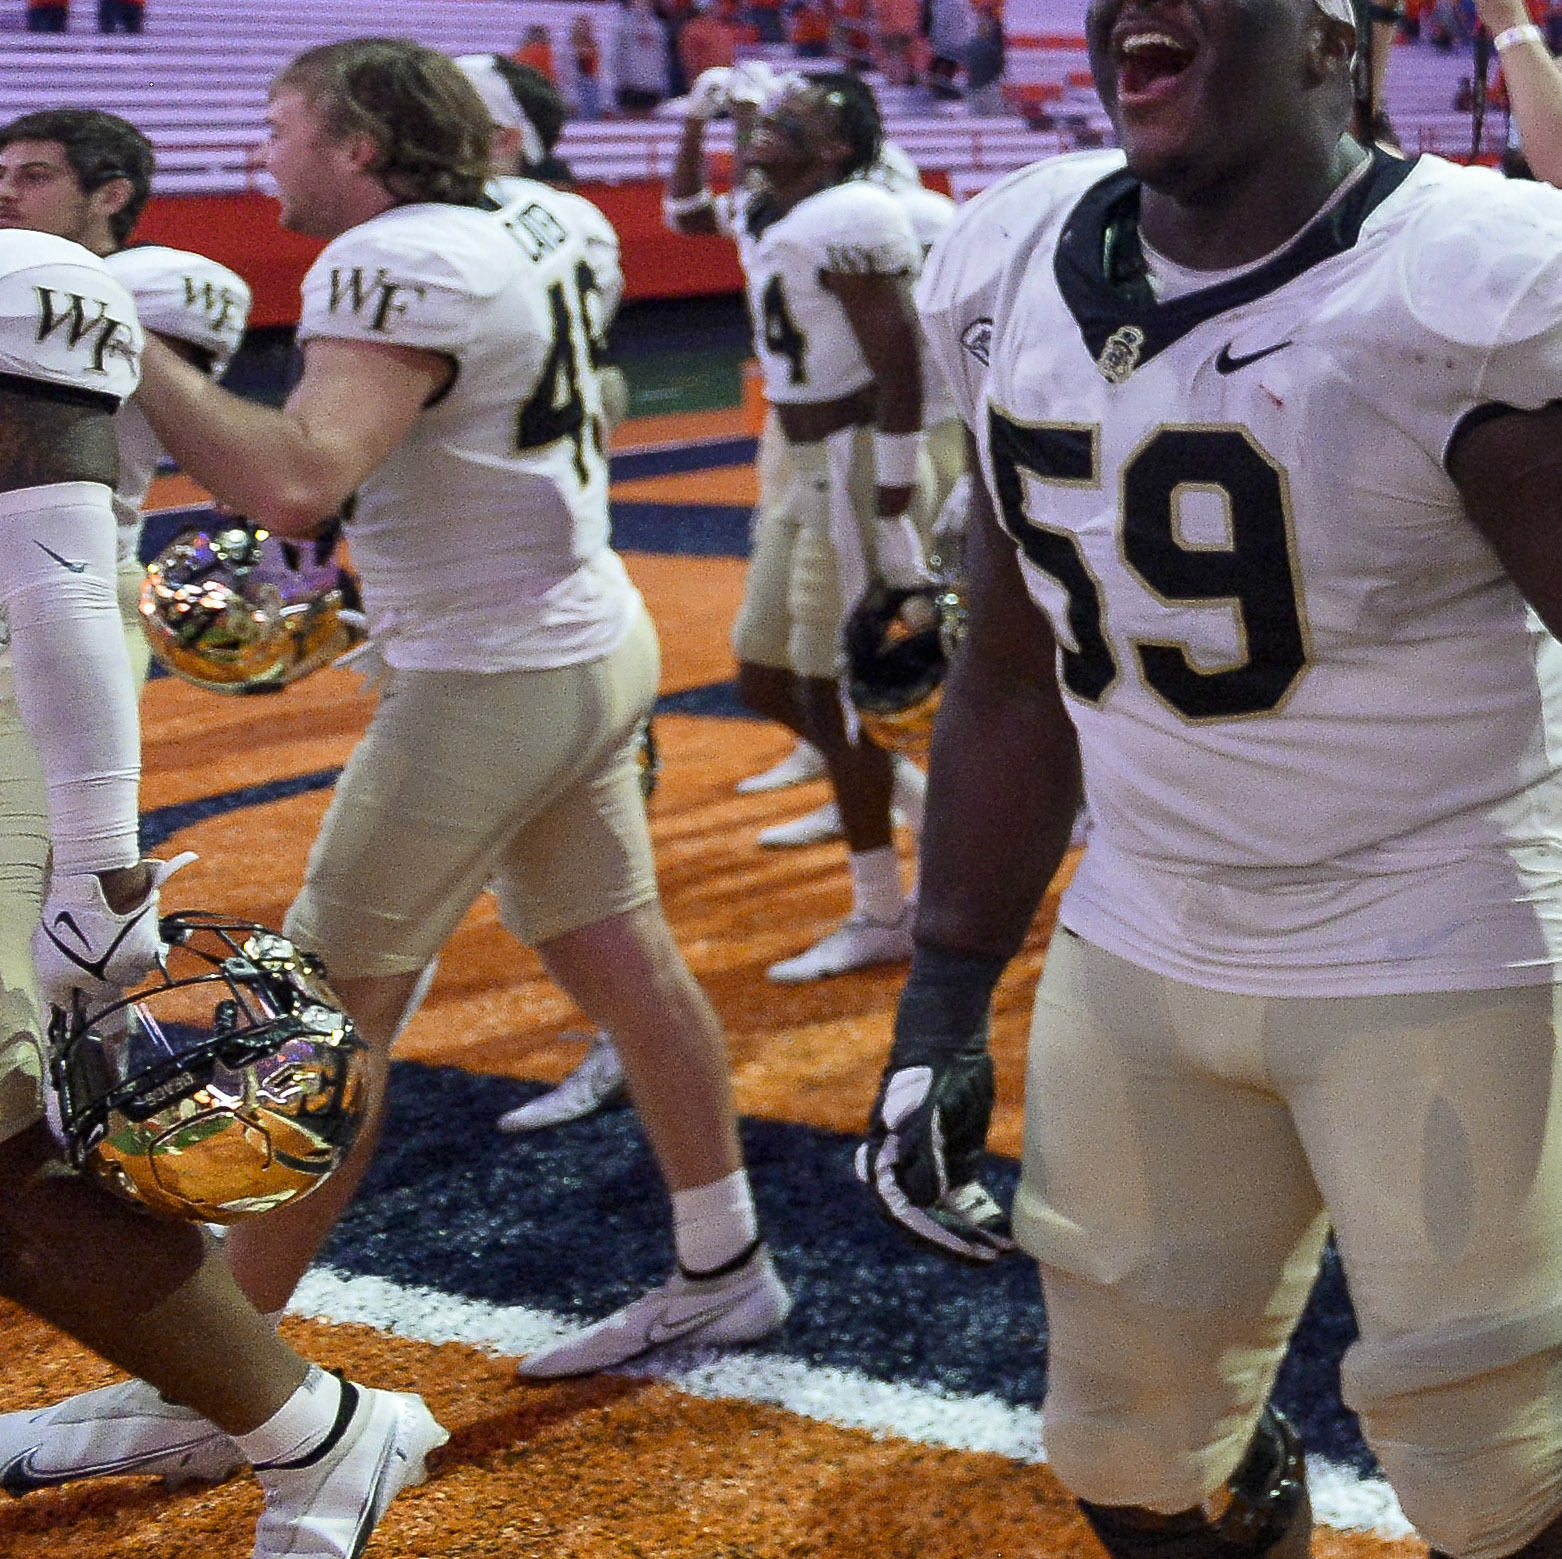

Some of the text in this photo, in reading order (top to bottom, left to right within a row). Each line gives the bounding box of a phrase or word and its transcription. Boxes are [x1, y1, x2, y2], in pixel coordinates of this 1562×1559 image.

[32, 285, 138, 376] WF
[326, 266, 428, 333] WF
[987, 396, 1311, 726] 59
